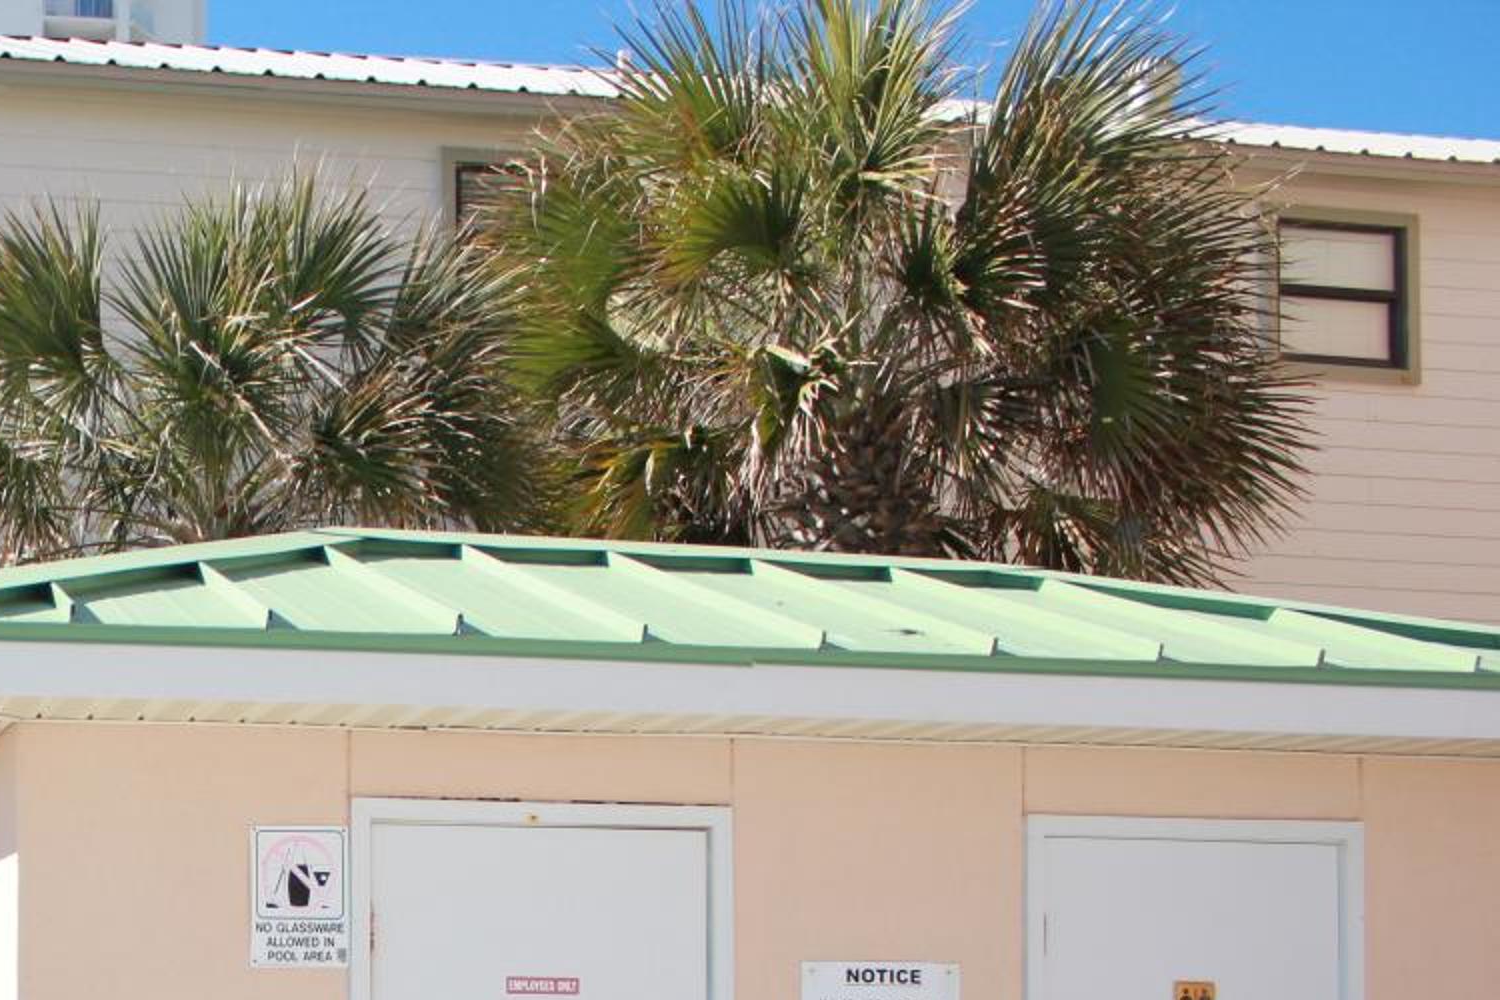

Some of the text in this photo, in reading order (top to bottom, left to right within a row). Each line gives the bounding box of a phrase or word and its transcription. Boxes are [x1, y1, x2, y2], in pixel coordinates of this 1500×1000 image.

[256, 921, 344, 933] NO GLASSWARE
[266, 936, 335, 948] ALLOWED IN
[267, 949, 297, 961] POOL
[303, 949, 333, 961] AREA
[846, 968, 922, 985] NOTICE
[509, 980, 577, 993] EMPLOYEES ONLY
